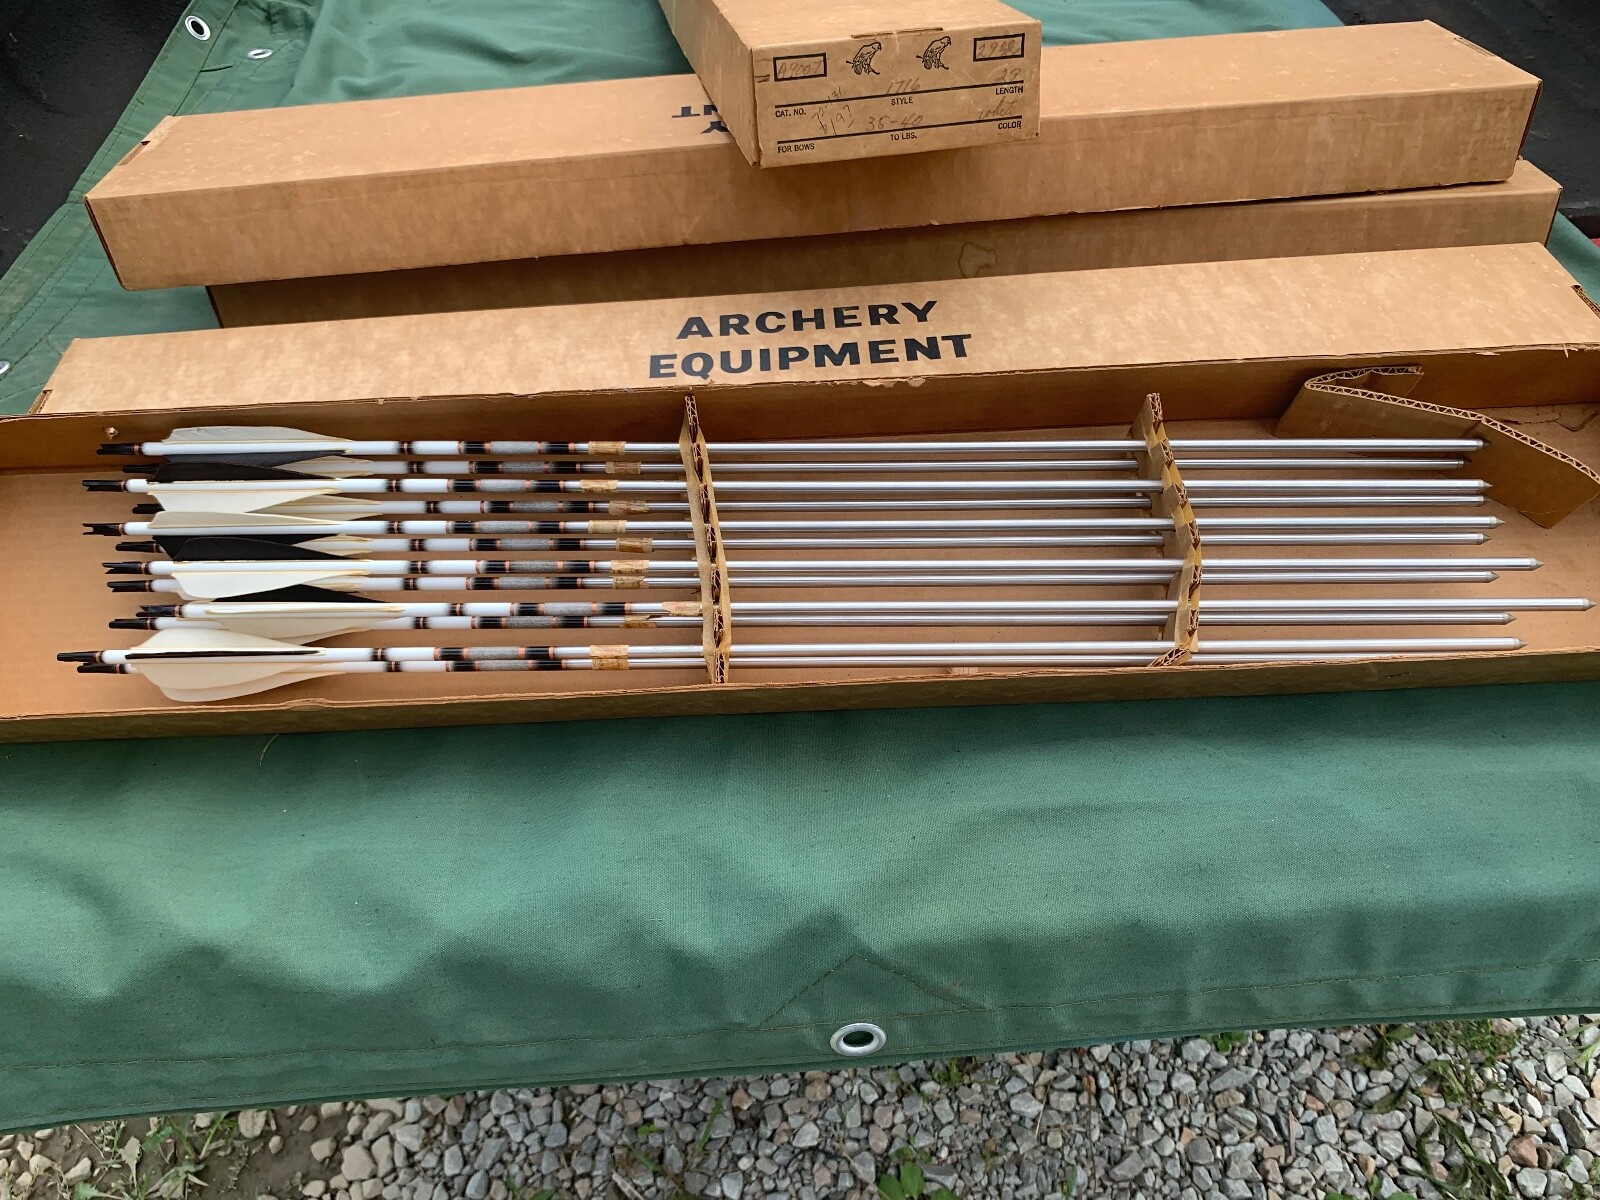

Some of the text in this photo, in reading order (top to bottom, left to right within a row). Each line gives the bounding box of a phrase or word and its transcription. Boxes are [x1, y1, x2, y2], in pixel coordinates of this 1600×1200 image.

[995, 85, 1024, 96] LENGTH
[891, 97, 914, 106] STYLE
[775, 108, 807, 118] CAT. NO.
[997, 120, 1022, 130] COLOR
[901, 131, 918, 140] LBS.
[778, 142, 815, 154] FOR BOWS
[676, 300, 938, 340] ARCHERY
[649, 333, 972, 380] EQUIPMENT
